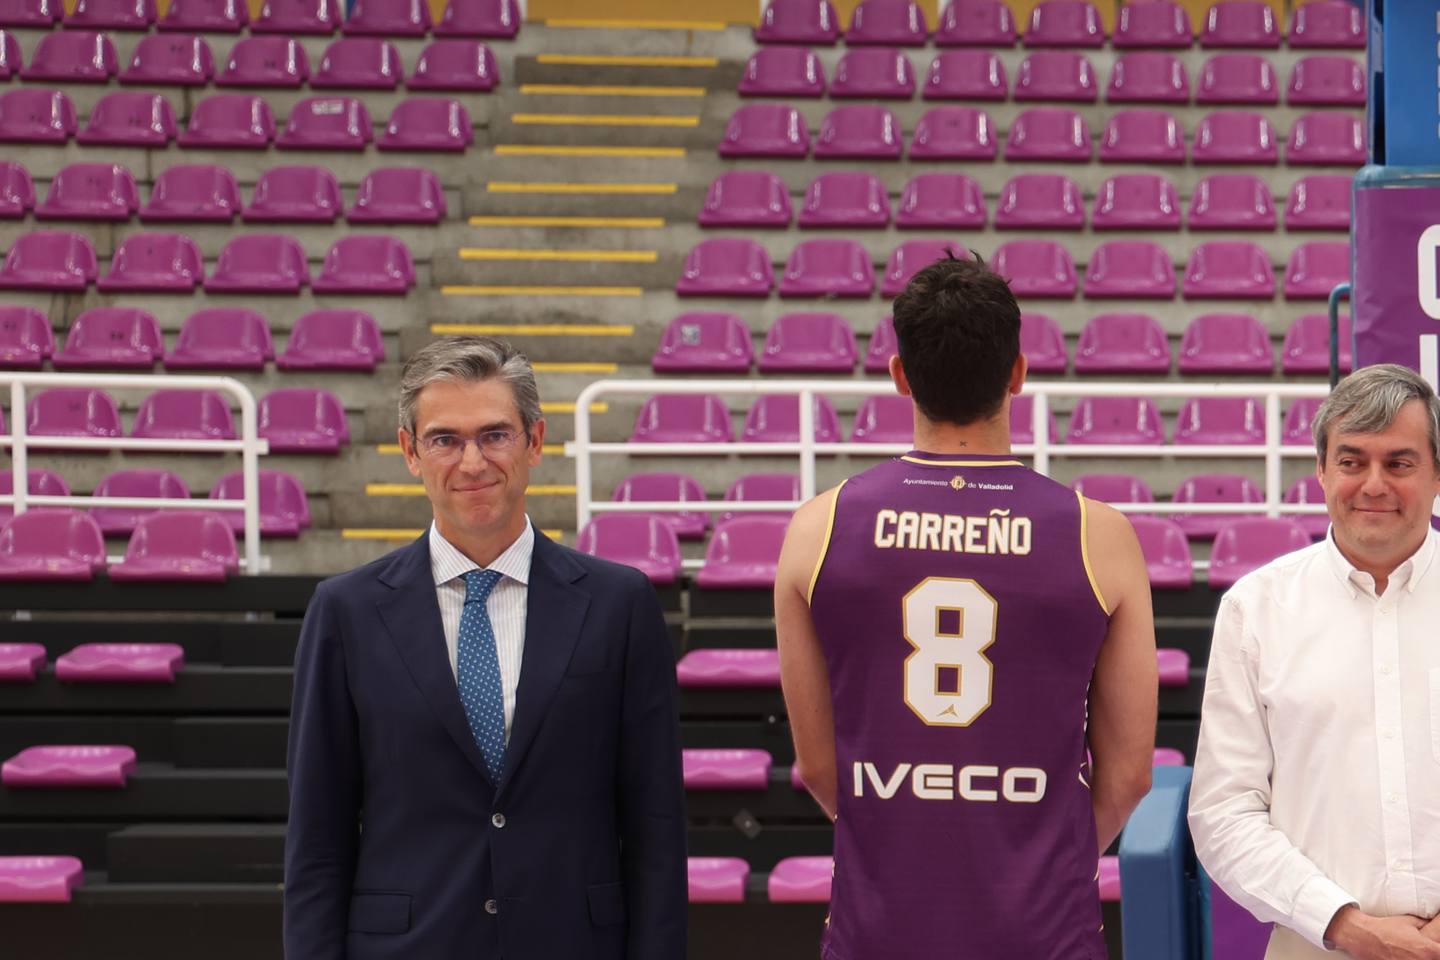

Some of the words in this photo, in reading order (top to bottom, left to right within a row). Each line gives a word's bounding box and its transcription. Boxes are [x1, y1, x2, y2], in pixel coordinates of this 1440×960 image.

[902, 477, 949, 488] Ayuntamiento
[967, 481, 977, 489] de
[978, 482, 1014, 491] Valladolid
[873, 508, 1033, 556] CARREÑO
[901, 575, 999, 728] 8
[852, 760, 1048, 804] IVECO
